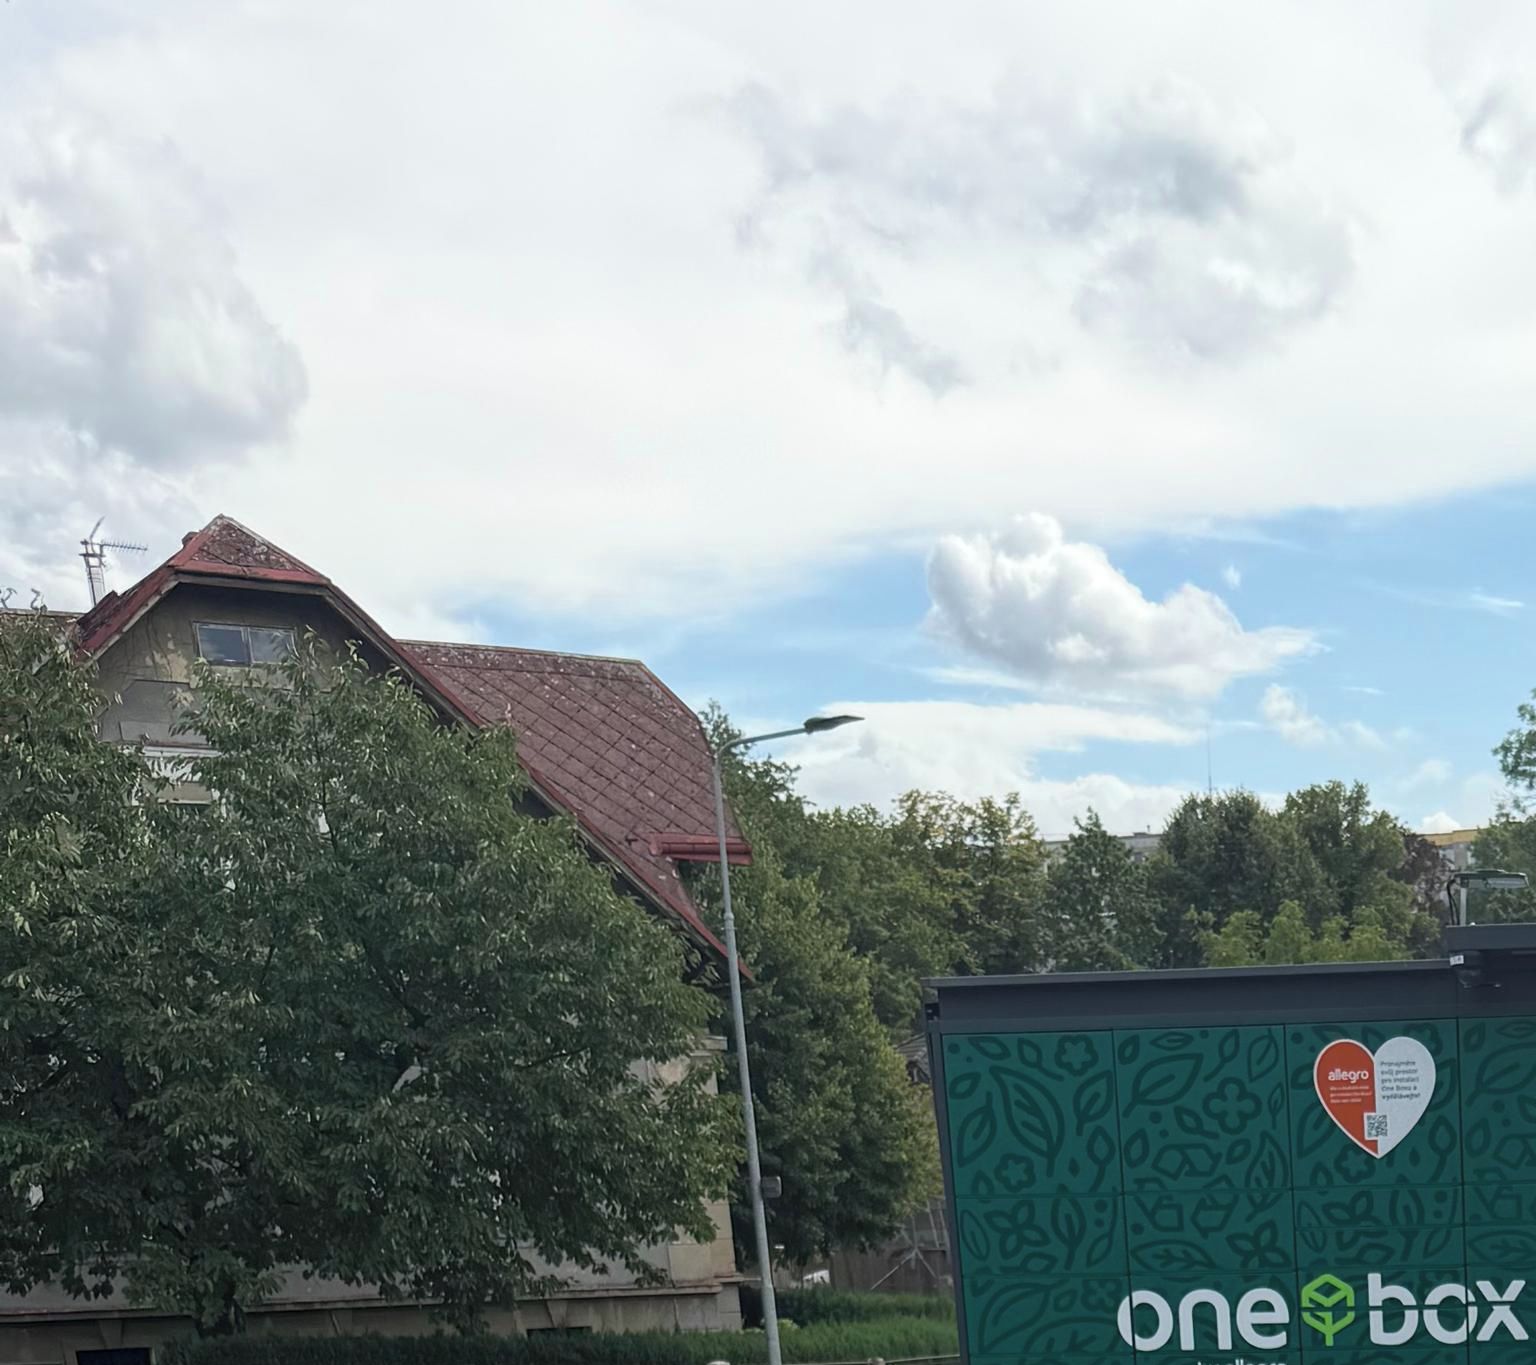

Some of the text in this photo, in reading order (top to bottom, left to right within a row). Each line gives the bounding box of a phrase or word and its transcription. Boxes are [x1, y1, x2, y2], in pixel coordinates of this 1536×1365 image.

[1328, 1068, 1369, 1083] allegro
[1117, 1273, 1529, 1351] one box
